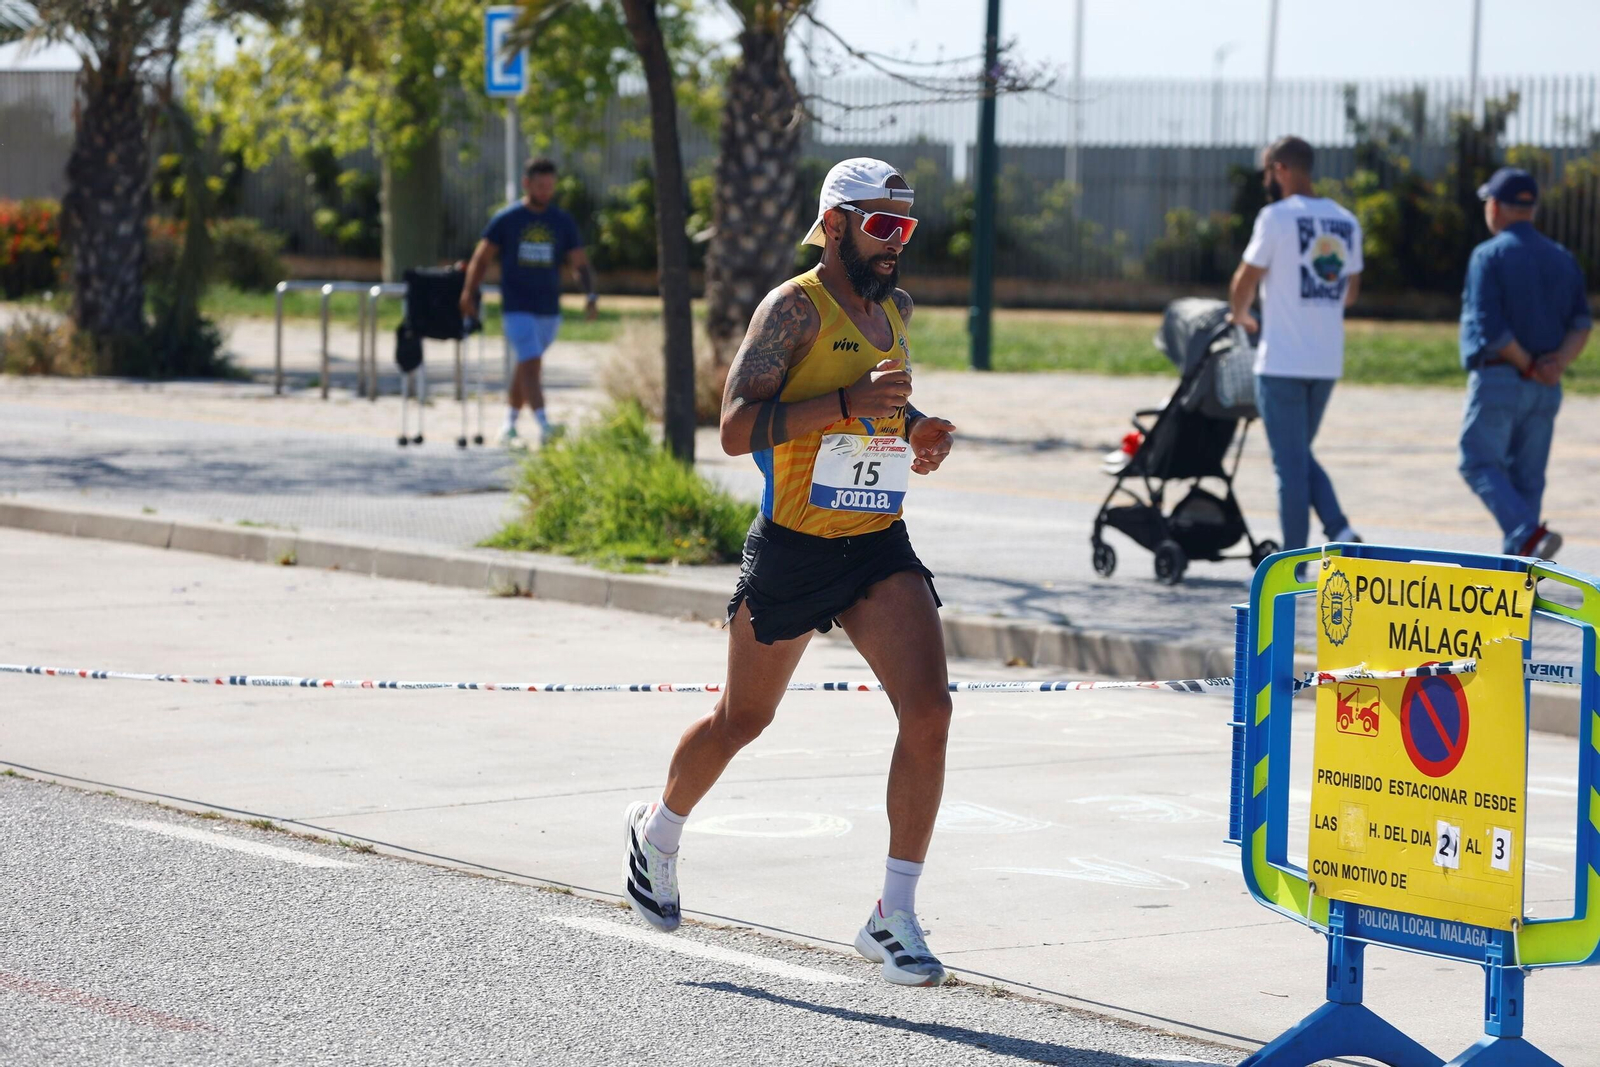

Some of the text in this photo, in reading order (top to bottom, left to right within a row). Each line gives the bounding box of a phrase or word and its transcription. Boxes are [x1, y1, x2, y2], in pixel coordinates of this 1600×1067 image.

[870, 437, 896, 446] RFEA
[853, 461, 881, 486] 15
[1356, 575, 1523, 618] POLICÍA LOCAL
[1389, 619, 1482, 659] MÁLAGA
[1529, 663, 1574, 679] LÍNEA
[1317, 769, 1517, 813] PROHIBIDO ESTACIONAR DESDE
[1315, 814, 1338, 831] LAS
[1369, 823, 1380, 839] H.
[1384, 825, 1408, 843] DEL
[1411, 829, 1432, 847] DIA
[1465, 838, 1482, 855] AL
[1494, 837, 1505, 860] 3
[1312, 859, 1407, 890] CON MOTIVO DE
[1358, 908, 1488, 948] POLICIA LOCAL MALAGA
